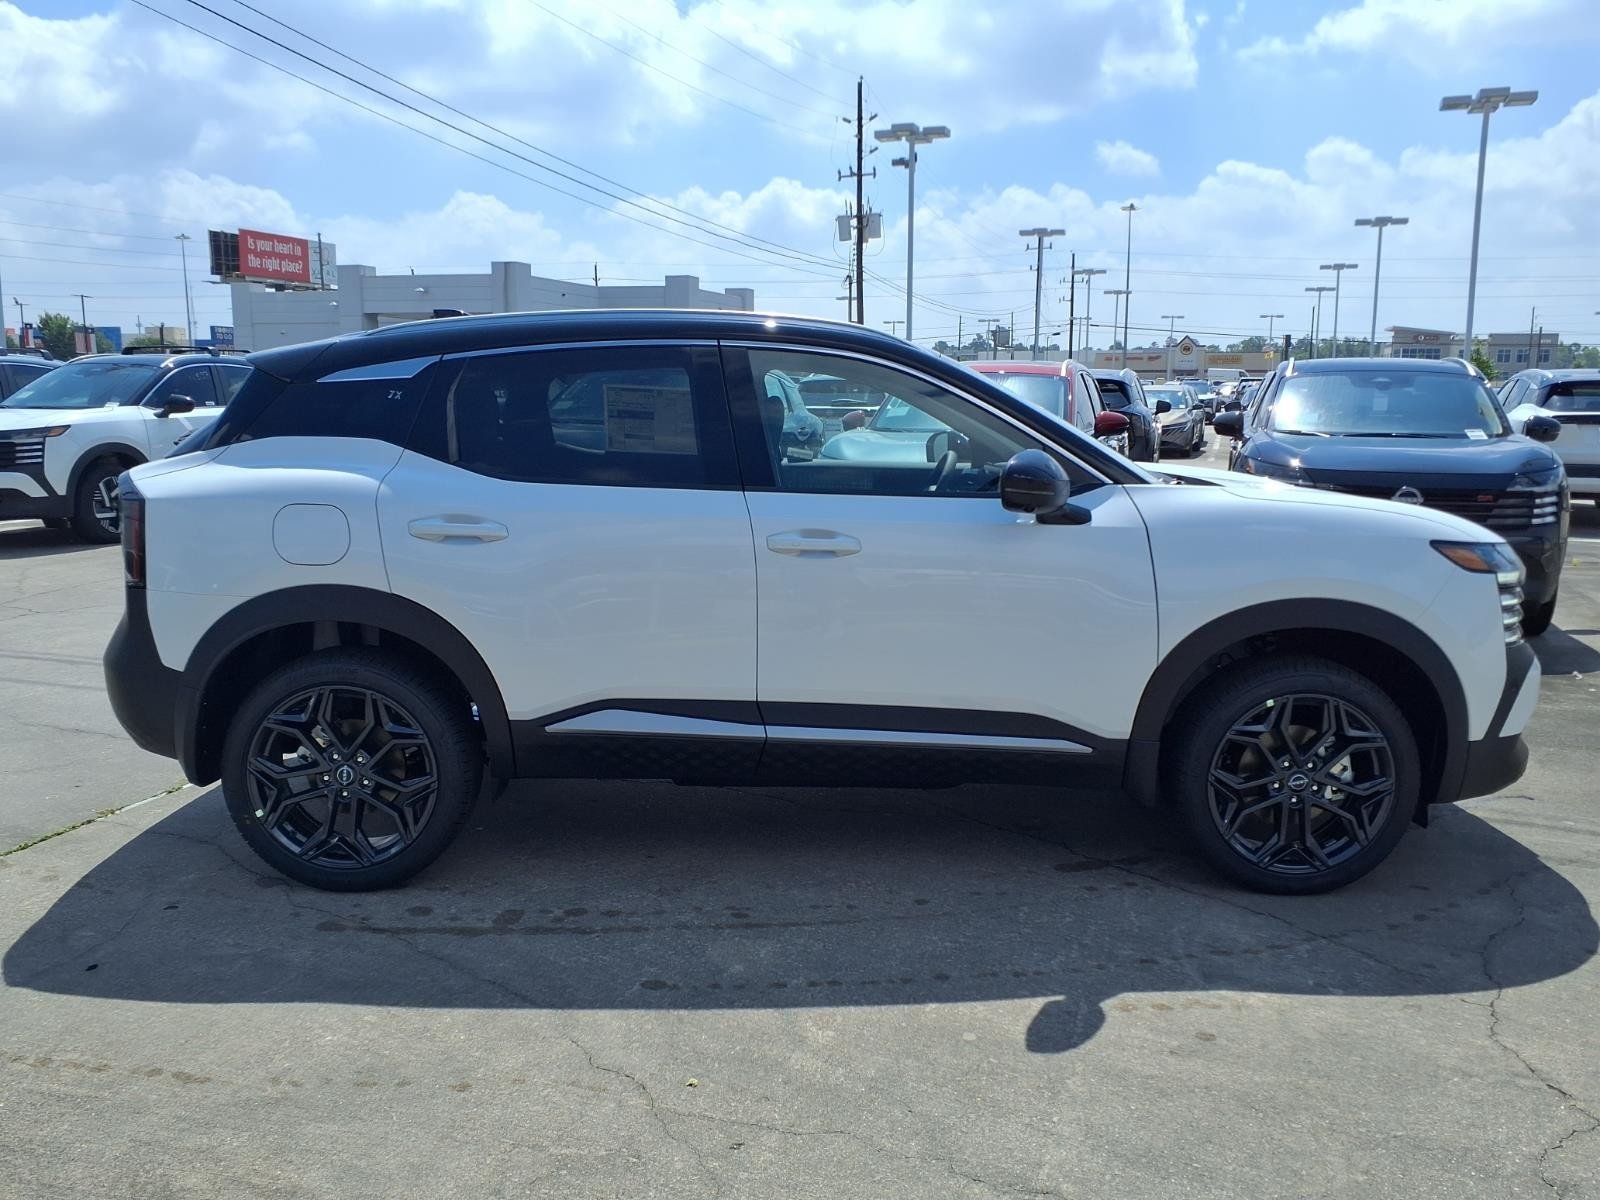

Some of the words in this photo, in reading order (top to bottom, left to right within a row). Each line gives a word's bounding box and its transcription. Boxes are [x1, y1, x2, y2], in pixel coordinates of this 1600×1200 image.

[247, 235, 255, 249] Is
[256, 238, 273, 252] your
[274, 239, 293, 255] heart
[294, 242, 302, 256] in
[247, 253, 261, 268] the
[262, 255, 281, 272] right
[281, 258, 303, 274] place?
